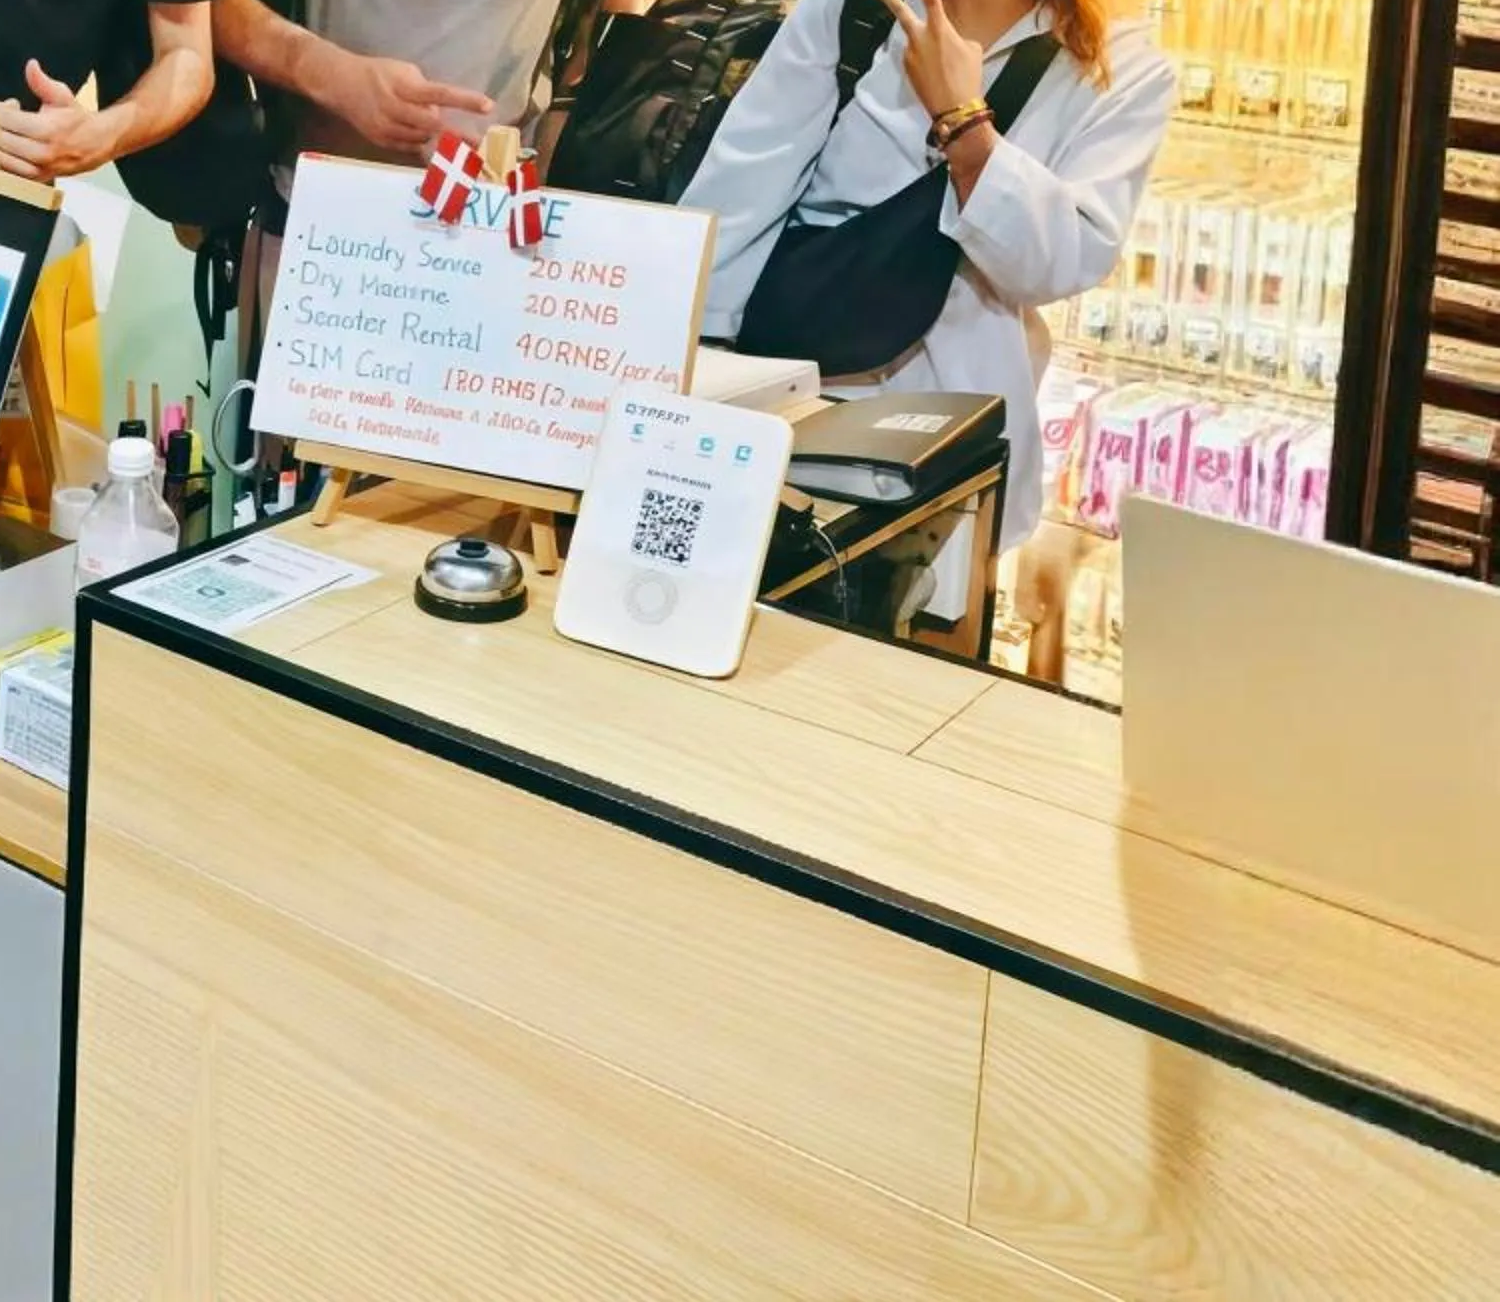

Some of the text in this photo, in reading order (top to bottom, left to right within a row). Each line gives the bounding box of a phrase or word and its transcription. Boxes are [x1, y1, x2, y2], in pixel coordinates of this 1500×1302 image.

[300, 260, 343, 298] Dry
[524, 293, 558, 318] 20
[530, 253, 563, 281] 20
[401, 311, 484, 354] Rental
[288, 339, 343, 370] SIM
[355, 349, 414, 386] Card
